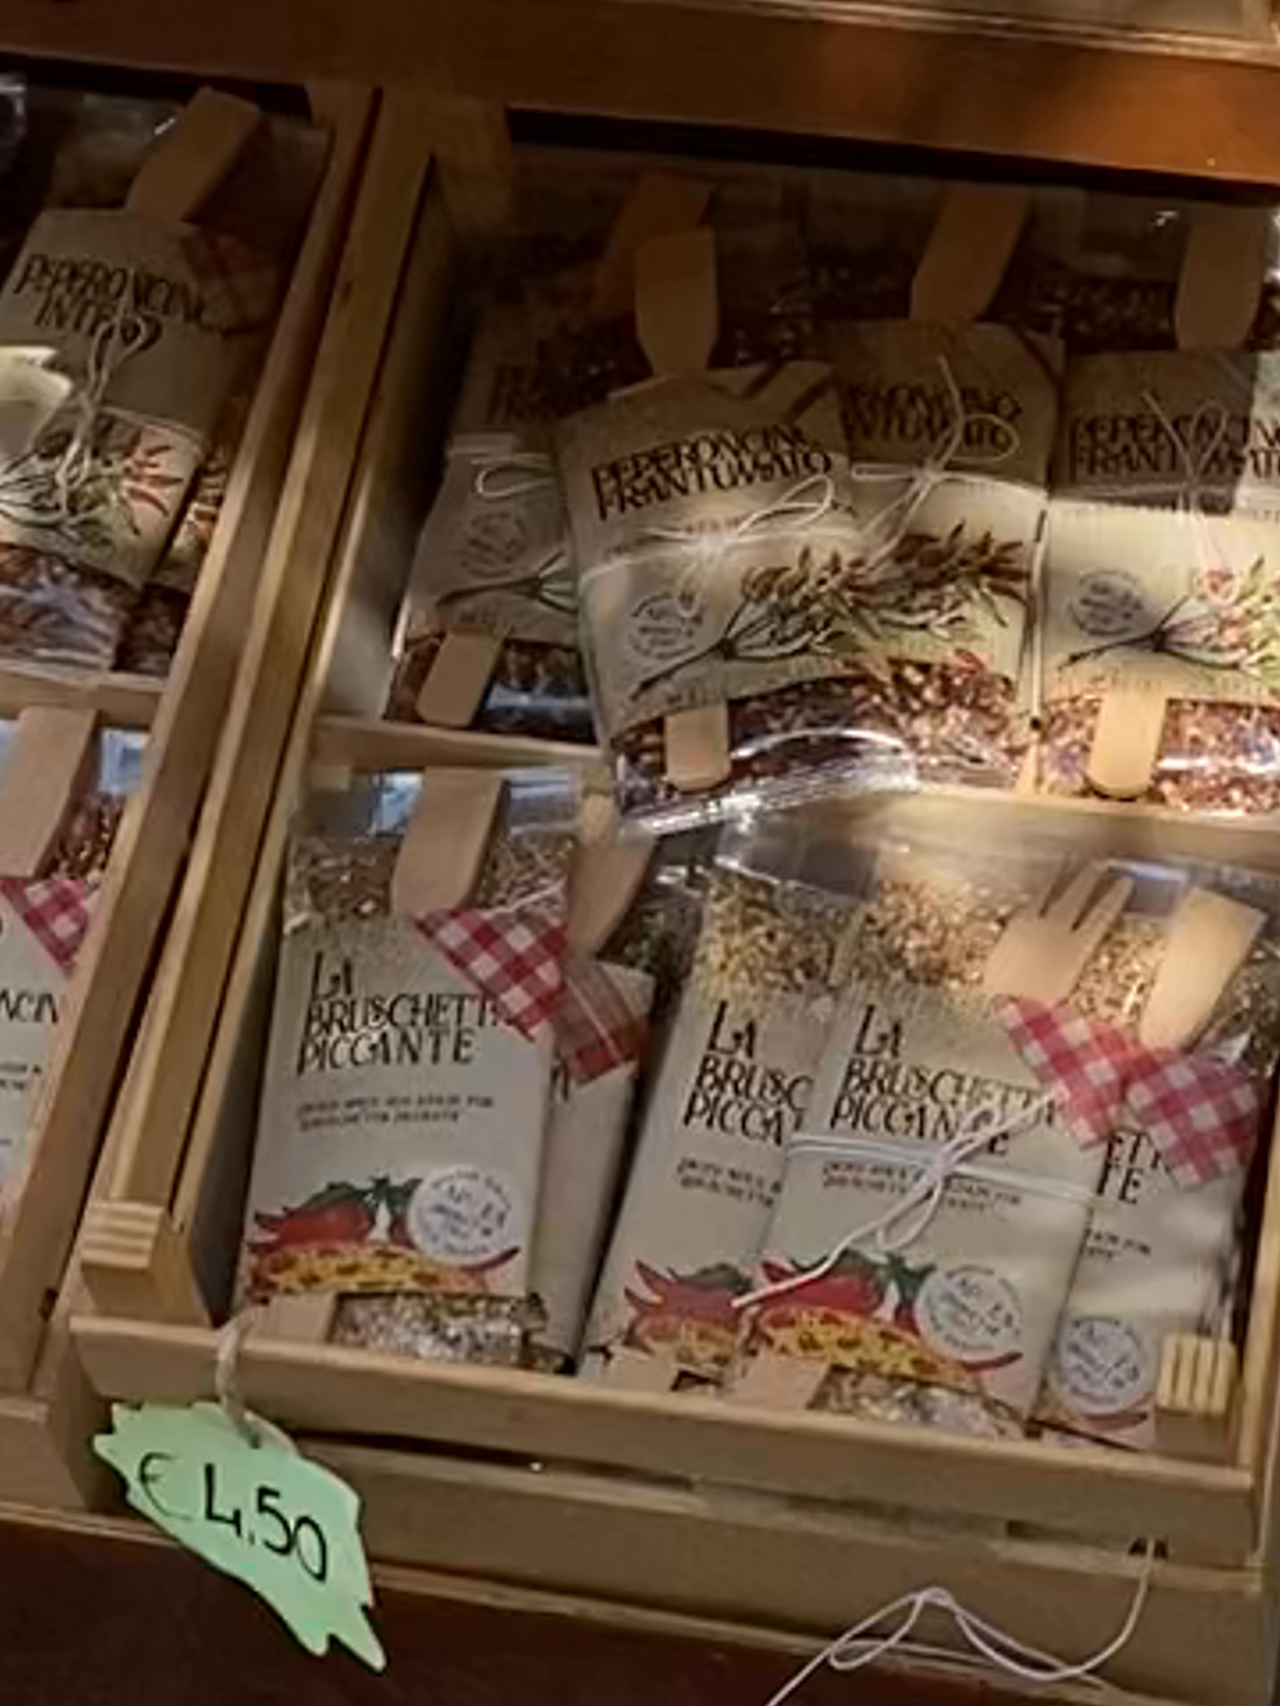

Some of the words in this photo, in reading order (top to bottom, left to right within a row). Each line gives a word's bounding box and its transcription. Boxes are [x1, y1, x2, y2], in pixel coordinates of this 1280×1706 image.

[311, 951, 353, 999] LA
[296, 1027, 477, 1078] PICCANTE
[707, 999, 758, 1059] LA
[853, 1002, 903, 1058] LA
[696, 1055, 814, 1113] BRUSC
[136, 1450, 194, 1523] €
